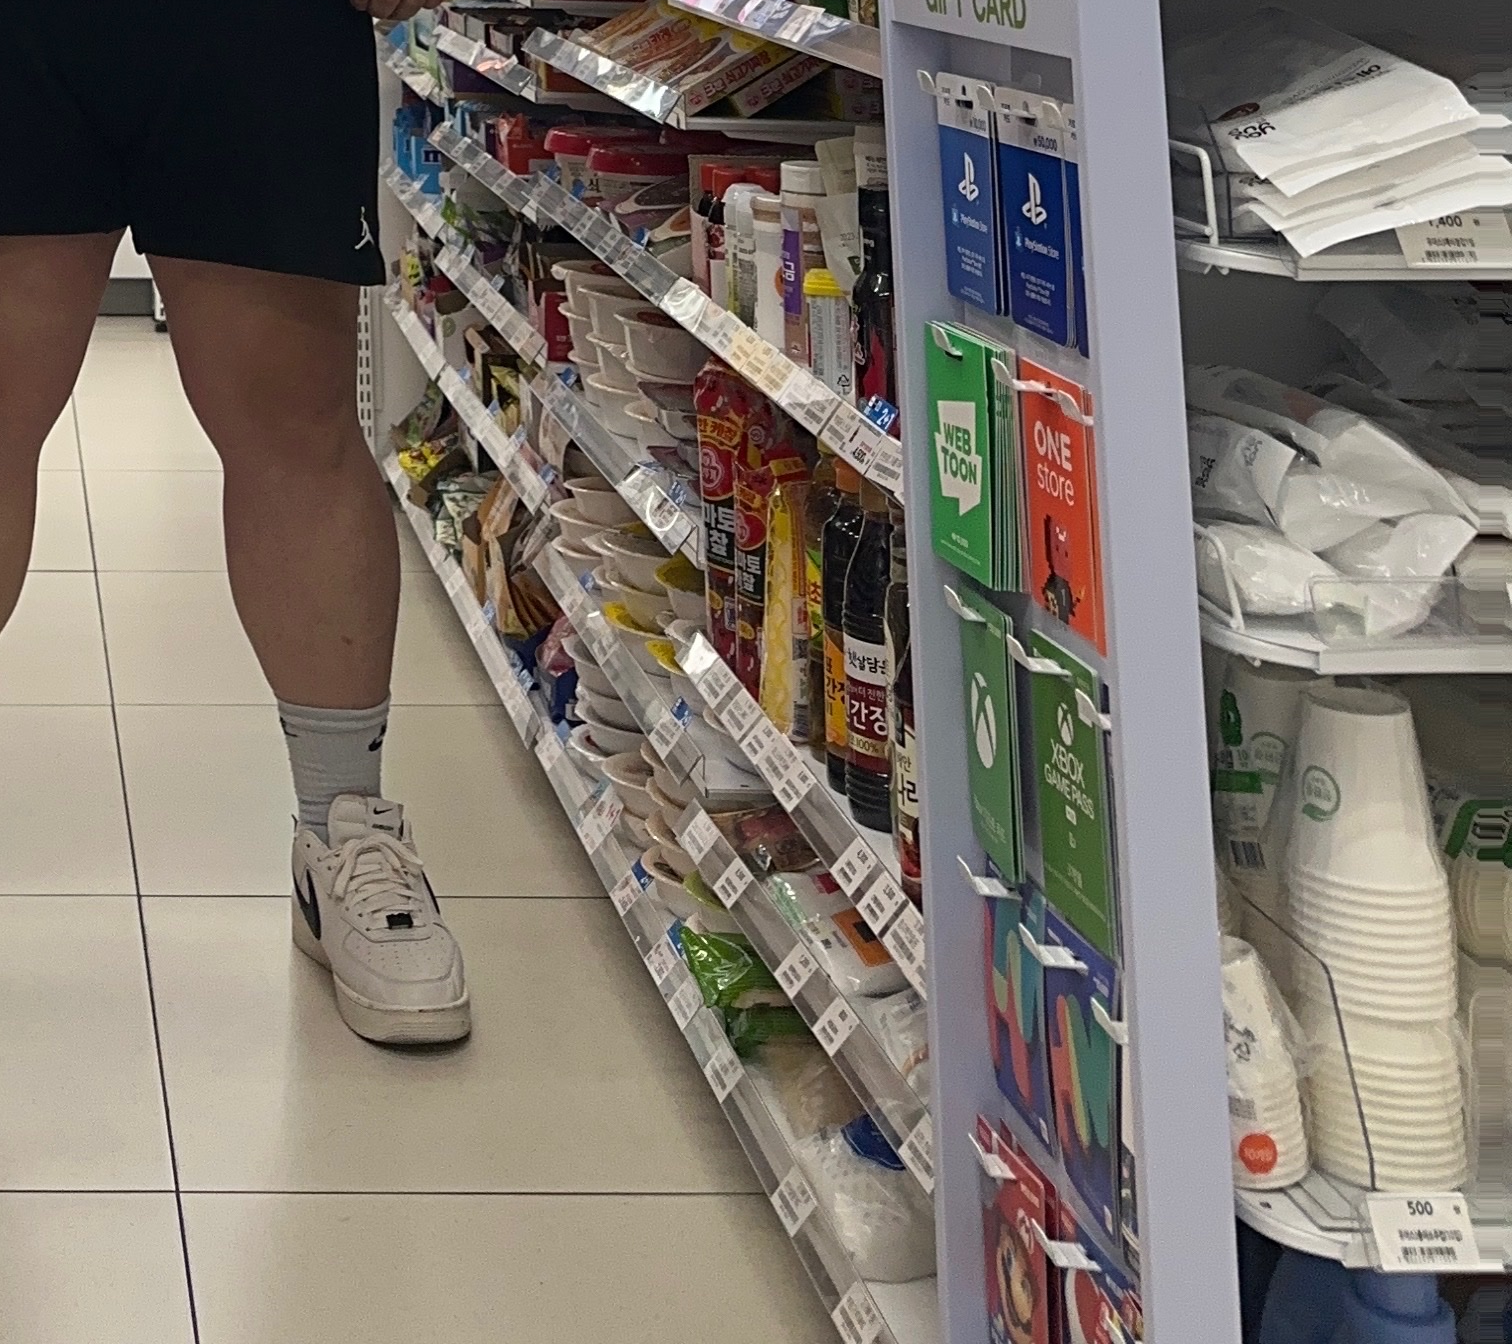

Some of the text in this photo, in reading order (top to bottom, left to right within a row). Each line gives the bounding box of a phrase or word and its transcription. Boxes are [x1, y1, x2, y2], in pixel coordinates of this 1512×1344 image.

[944, 423, 973, 457] WEB
[1034, 421, 1073, 472] ONE
[941, 449, 978, 486] TOON
[1038, 463, 1075, 506] store
[1050, 739, 1085, 788] XBOX
[1044, 764, 1095, 820] GAME PASS
[1407, 1200, 1434, 1216] 500
